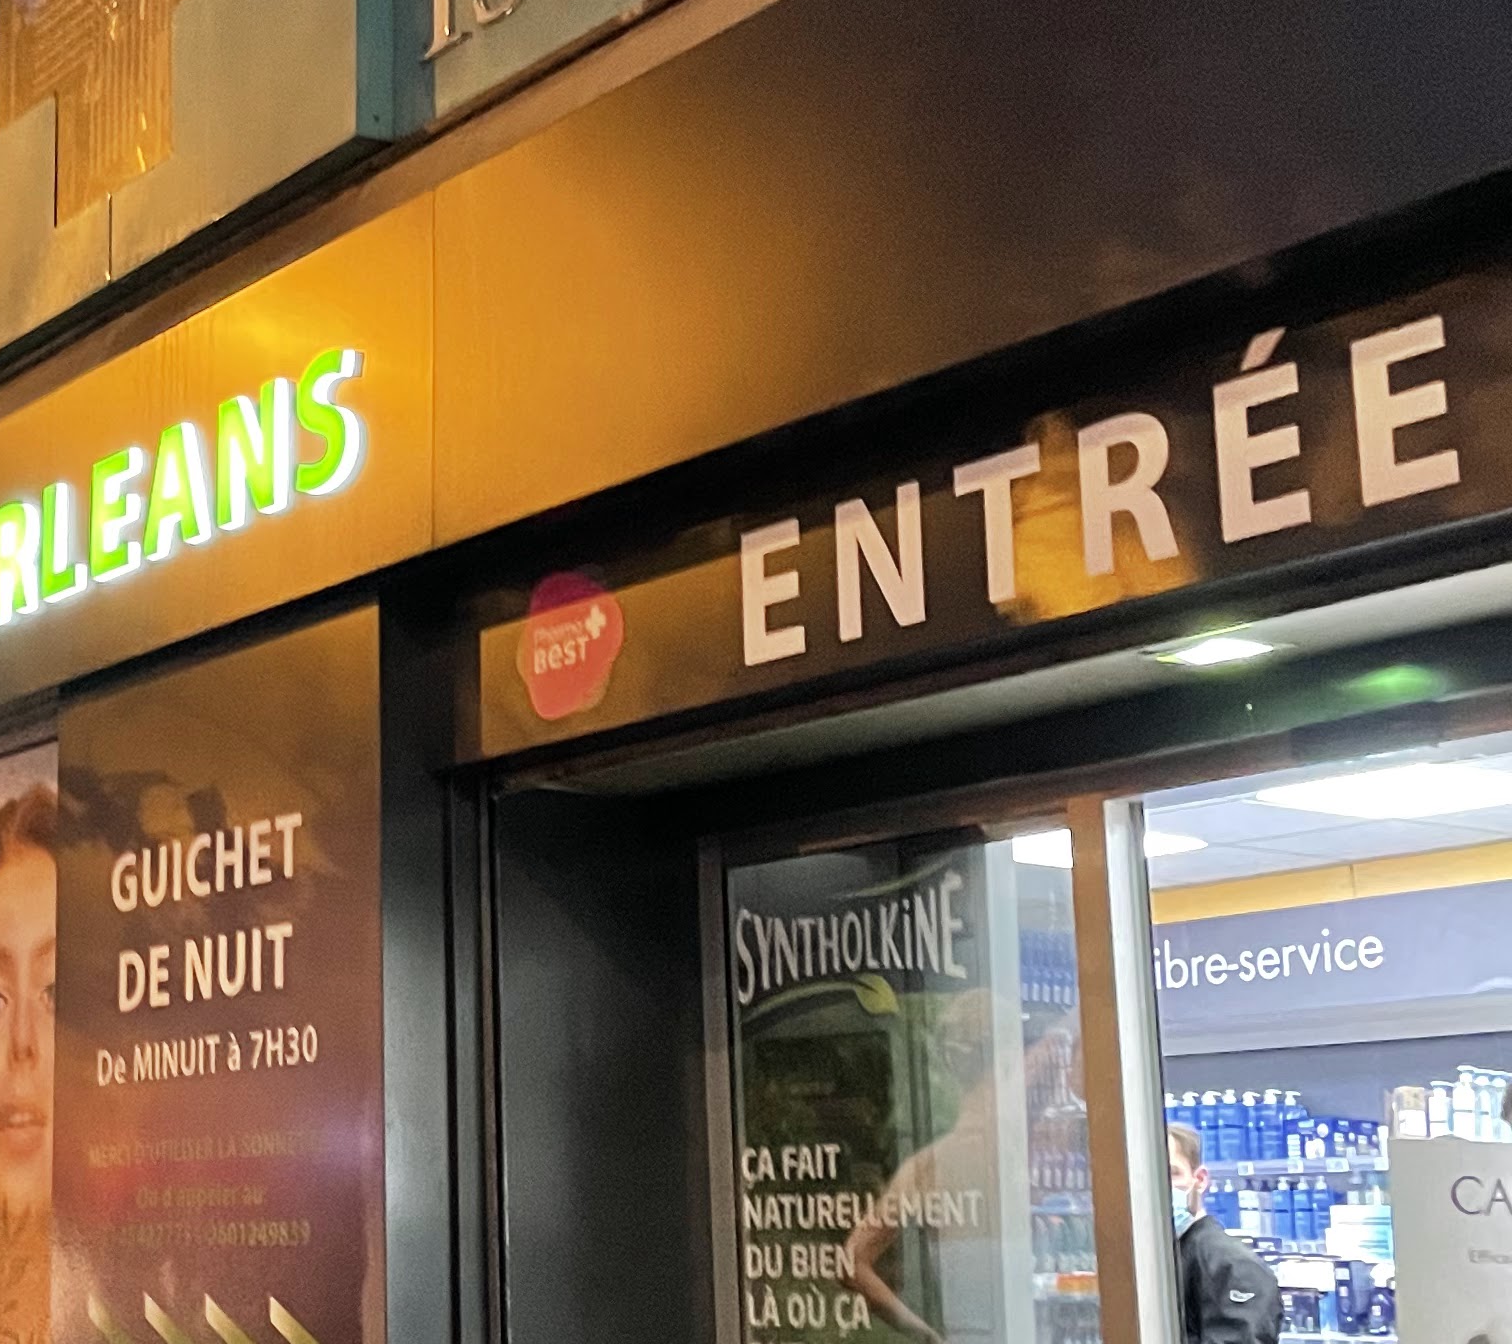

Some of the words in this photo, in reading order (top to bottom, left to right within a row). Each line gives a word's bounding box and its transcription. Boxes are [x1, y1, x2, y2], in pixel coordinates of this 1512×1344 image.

[740, 315, 1460, 667] ENTRÉE
[111, 812, 302, 912] GUICHET
[118, 945, 170, 1012] DE
[185, 923, 293, 1002] NUIT
[97, 1049, 126, 1086] De
[133, 1034, 220, 1082] MINUIT
[227, 1031, 241, 1071] à
[249, 1024, 318, 1069] 7H30
[742, 1145, 776, 1189] ÇA
[781, 1143, 841, 1181] FAIT
[743, 1188, 982, 1231] NATURELLEMENT
[746, 1243, 784, 1280] DU
[791, 1242, 856, 1281] BIEN
[746, 1284, 781, 1328] LÀ
[788, 1282, 827, 1329] OÙ
[835, 1292, 872, 1337] ÇA
